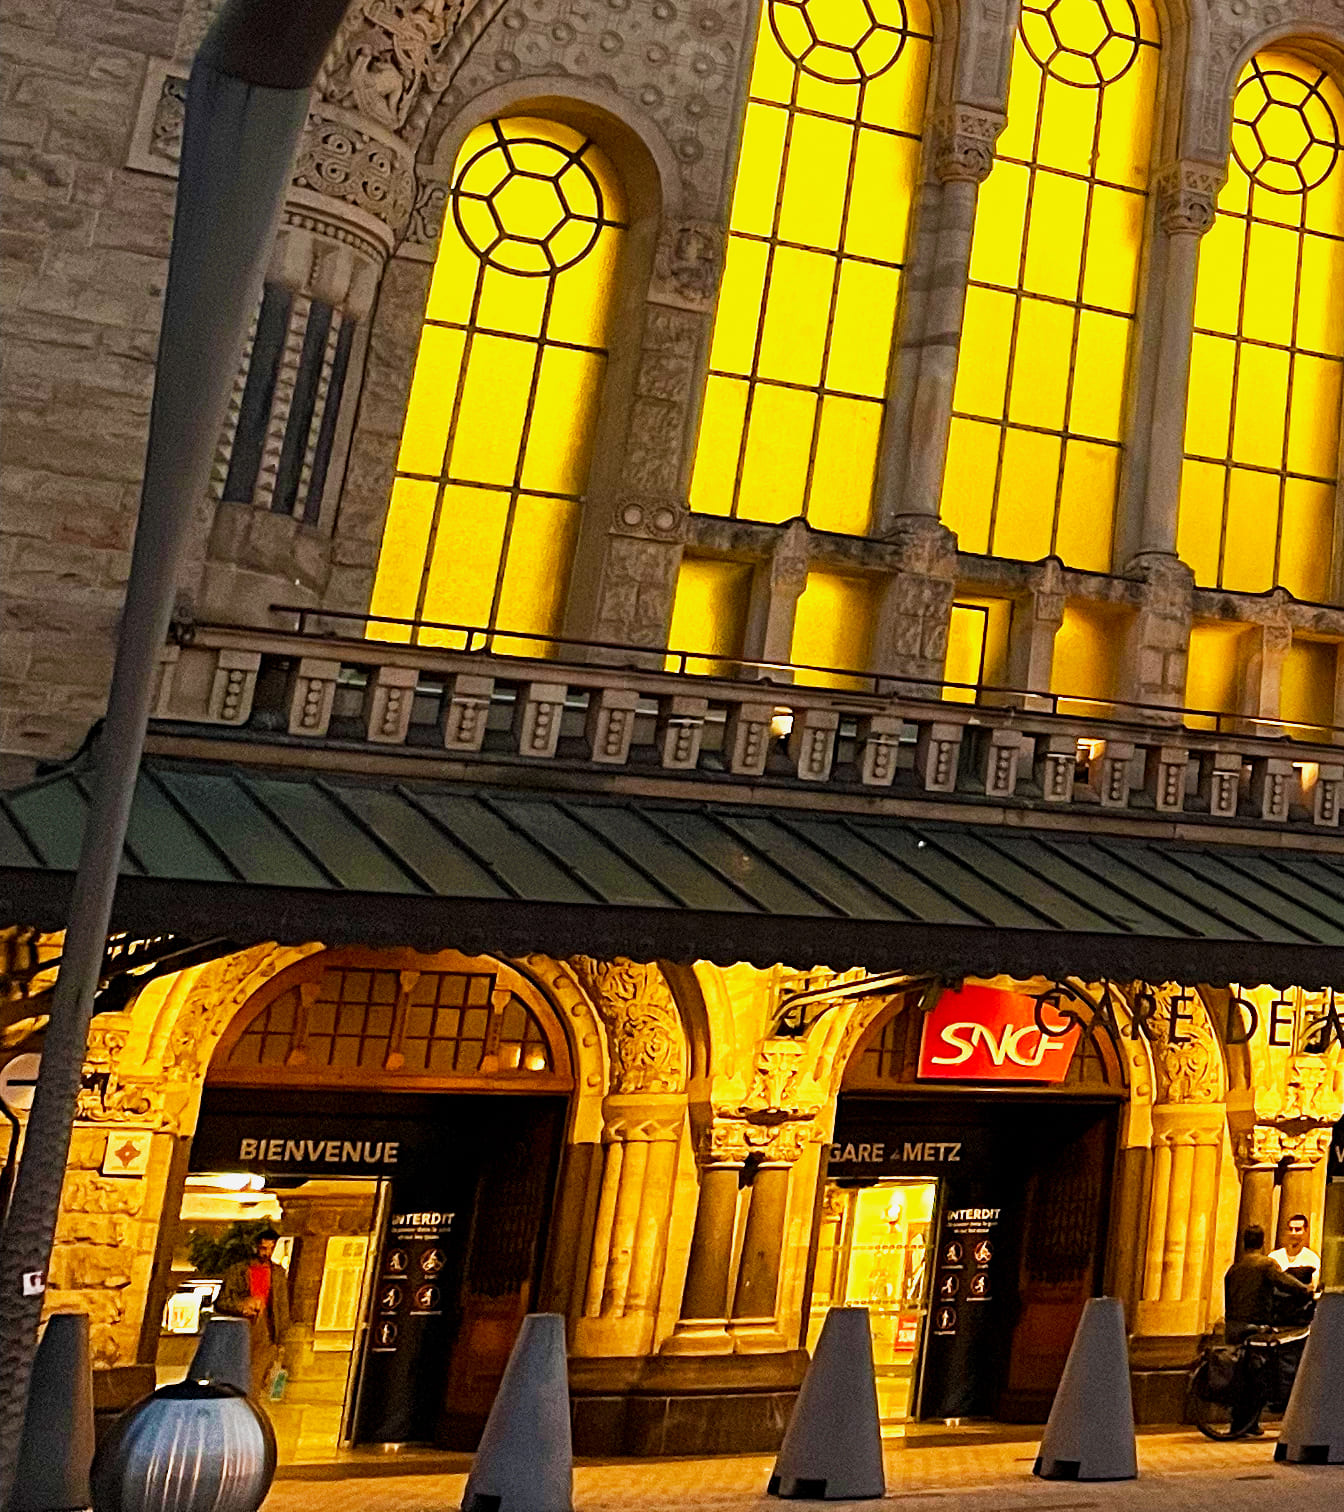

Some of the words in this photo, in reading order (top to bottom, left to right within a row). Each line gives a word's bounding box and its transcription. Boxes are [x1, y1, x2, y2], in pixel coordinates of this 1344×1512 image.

[1034, 987, 1194, 1044] GARE
[1226, 996, 1295, 1047] DE
[931, 1022, 1069, 1066] SNCF
[239, 1138, 400, 1164] BIENVENUE
[829, 1142, 885, 1163] GARE
[902, 1142, 962, 1162] METZ
[391, 1212, 456, 1226] INTERDIT
[947, 1208, 1001, 1221] INTERDIT
